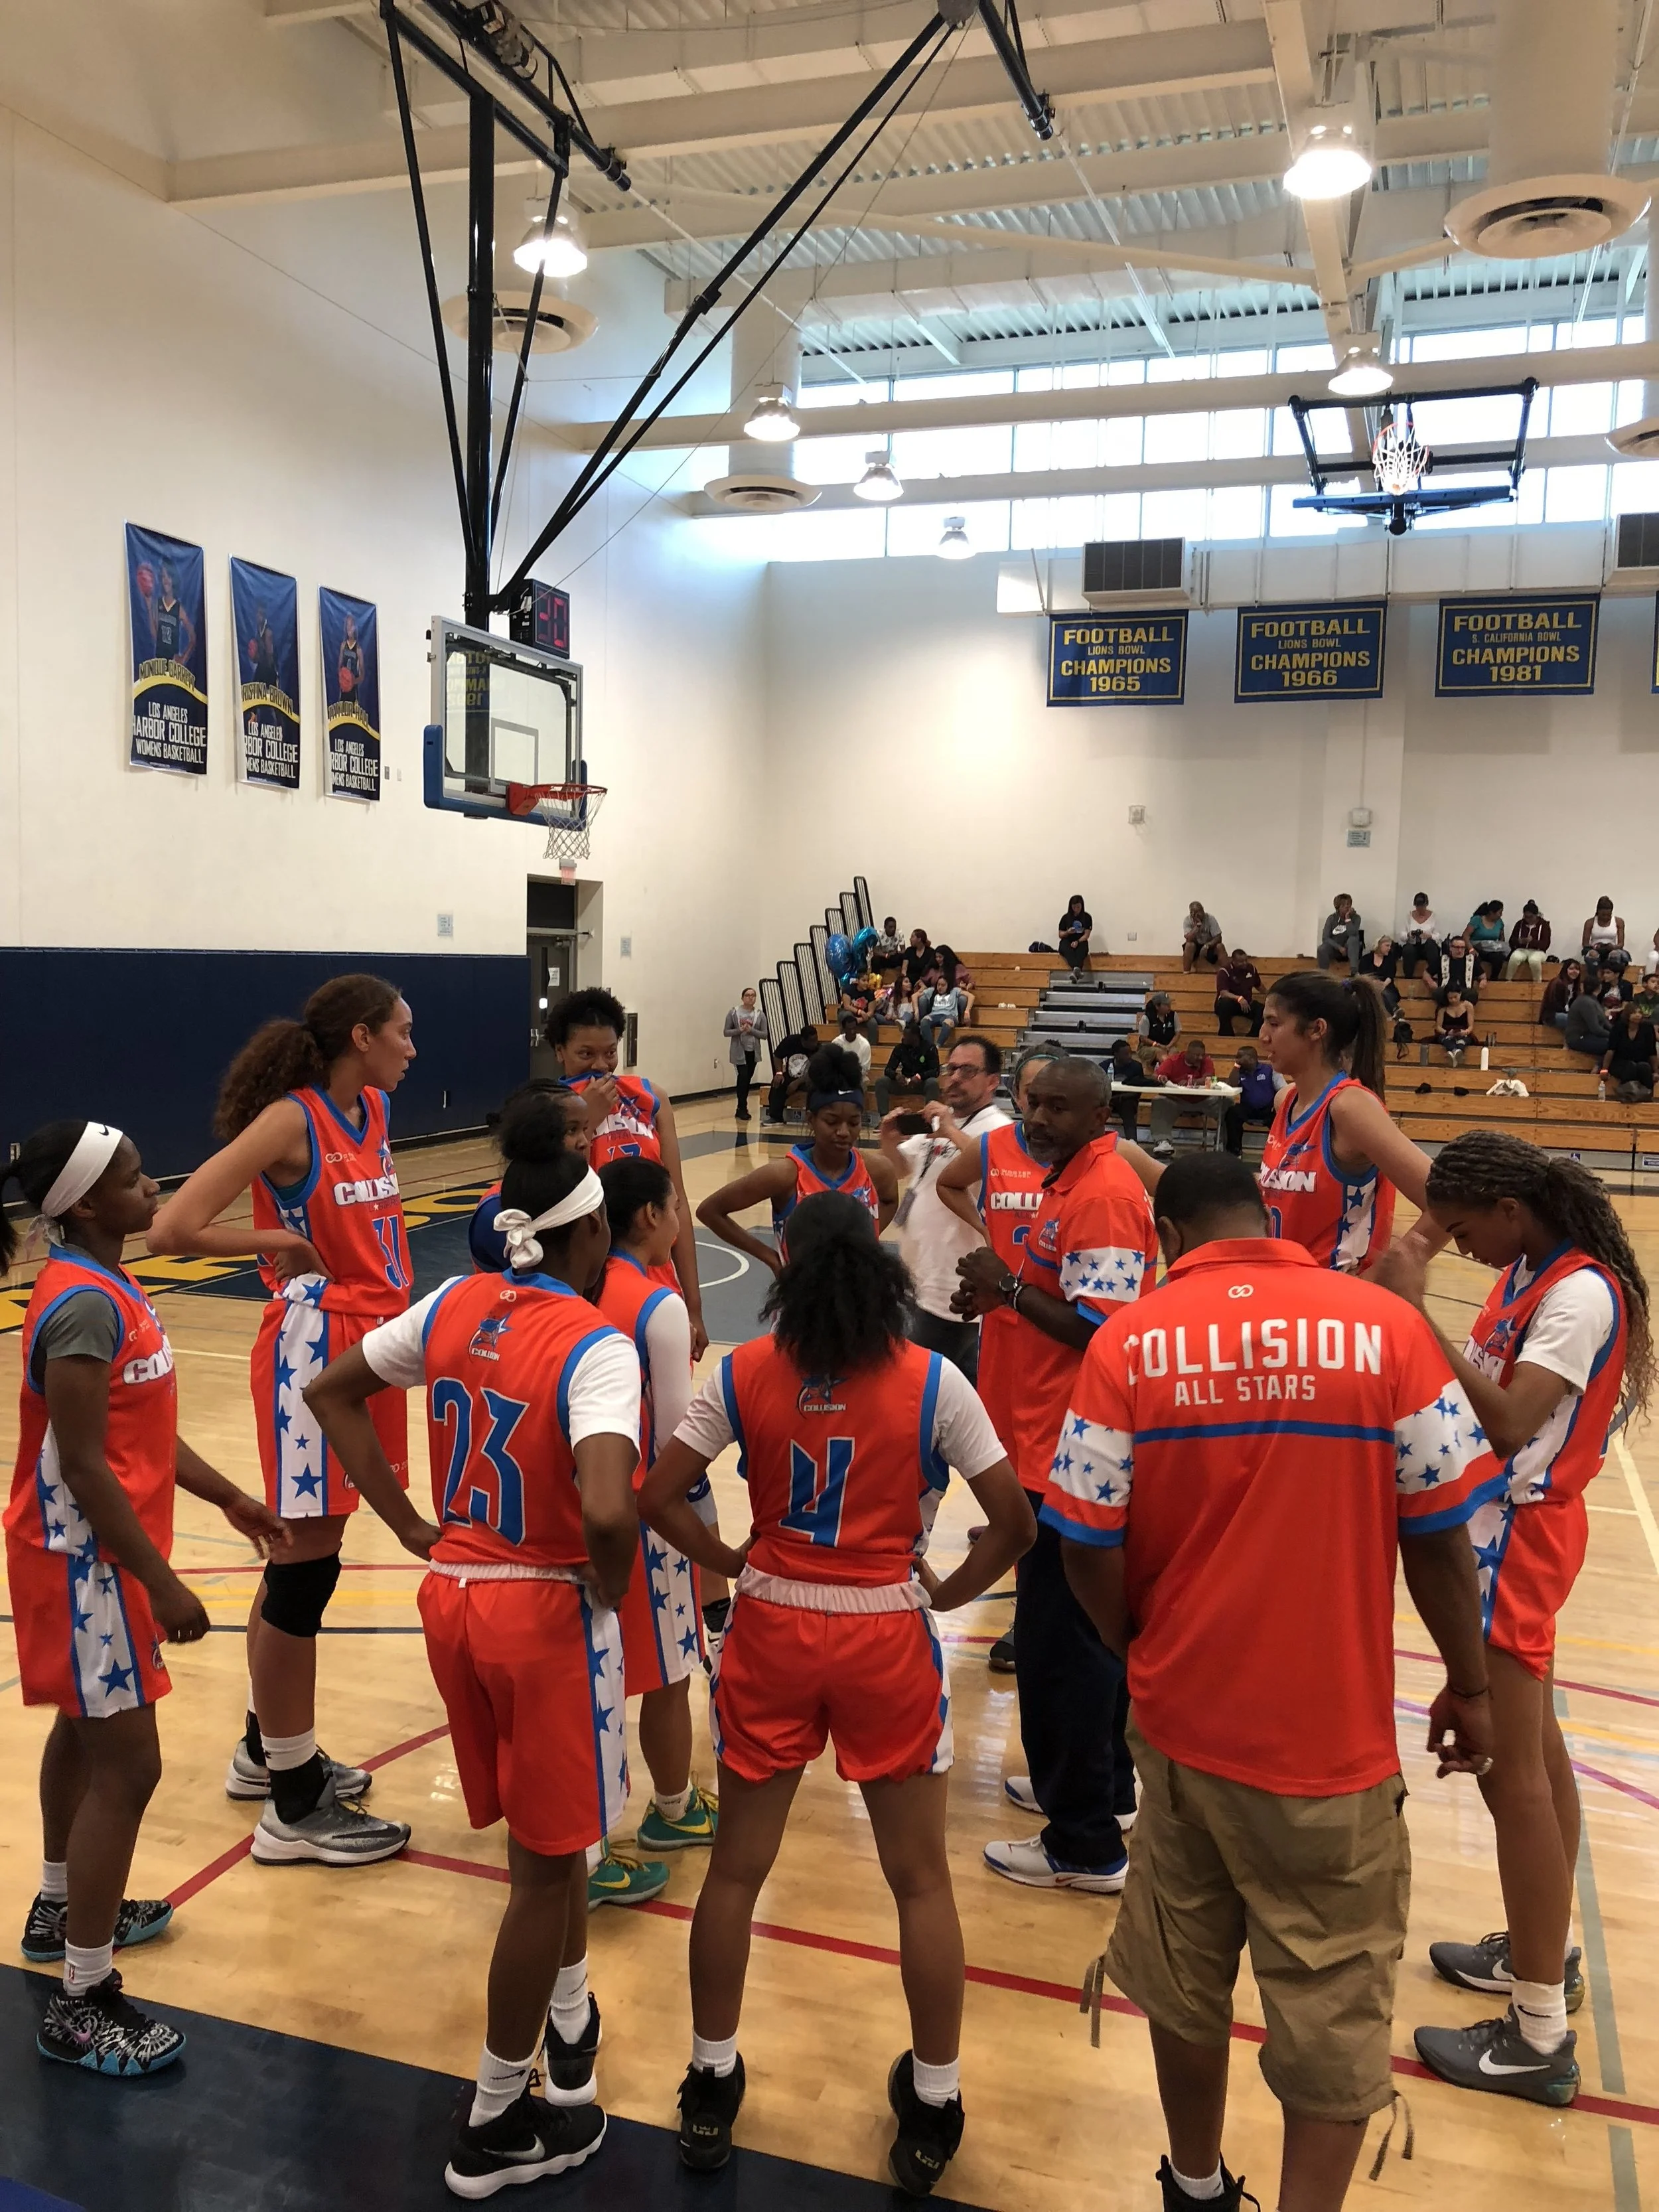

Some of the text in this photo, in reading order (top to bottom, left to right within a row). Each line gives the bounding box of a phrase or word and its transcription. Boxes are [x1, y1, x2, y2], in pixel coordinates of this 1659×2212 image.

[1251, 619, 1370, 638] FOOTBALL
[1454, 611, 1582, 632] FOOTBALL
[1064, 627, 1175, 646] FOOTBALL
[1278, 638, 1341, 650] LIONS BOWL
[1484, 632, 1534, 644] CALIFORNIA
[1537, 631, 1561, 642] BOWL
[1088, 644, 1145, 656] LIONS BOWL
[1251, 650, 1370, 670] CHAMPIONS
[1452, 645, 1580, 665] CHAMPIONS
[139, 658, 196, 691] MONIQUE GARRETT
[1061, 658, 1171, 676] CHAMPIONS
[1490, 665, 1542, 682] 1981
[1090, 676, 1141, 693] 1965
[1281, 670, 1338, 687] 1966
[241, 682, 293, 715] RISTINA BROWN
[148, 701, 188, 724] LOS ANGELES
[328, 700, 354, 721] TAYLOR
[169, 721, 206, 747] COLLEGE
[248, 721, 283, 742] LOS ANGELES
[135, 738, 204, 764] WOMENS BASKETBALL
[244, 735, 299, 763] RBOR COLLEGE
[334, 738, 364, 757] LOS ANGELES
[260, 759, 296, 779] BASKETBALL
[330, 751, 379, 777] RBOR COLLEGE
[345, 773, 376, 792] BASKETBALL
[372, 1214, 409, 1290] 31
[1175, 1374, 1316, 1407] ALL STARS
[803, 1403, 846, 1412] COLLISION
[432, 1376, 531, 1548] 23
[778, 1436, 855, 1548] 4
